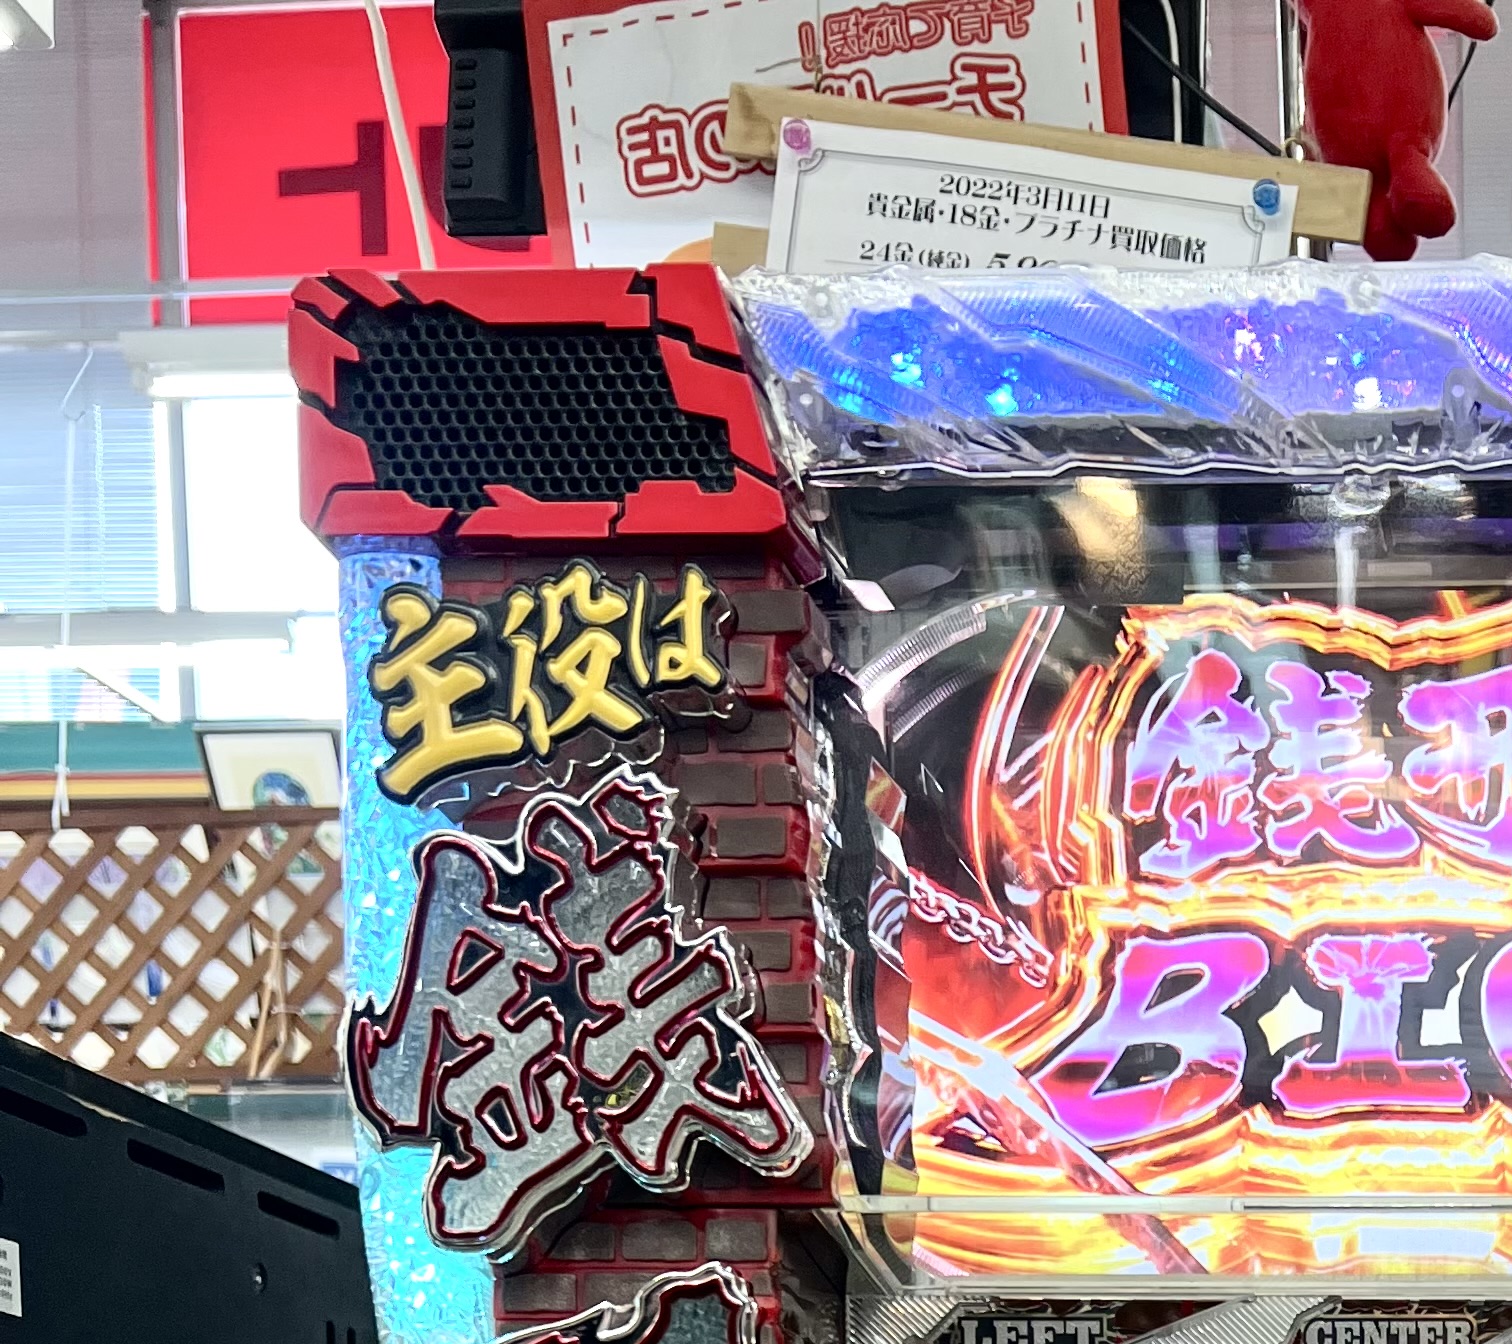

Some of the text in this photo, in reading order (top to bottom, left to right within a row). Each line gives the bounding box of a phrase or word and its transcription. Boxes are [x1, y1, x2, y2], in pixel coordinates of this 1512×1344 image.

[938, 173, 1111, 219] 2022年3月11日
[370, 563, 725, 797] 主役は
